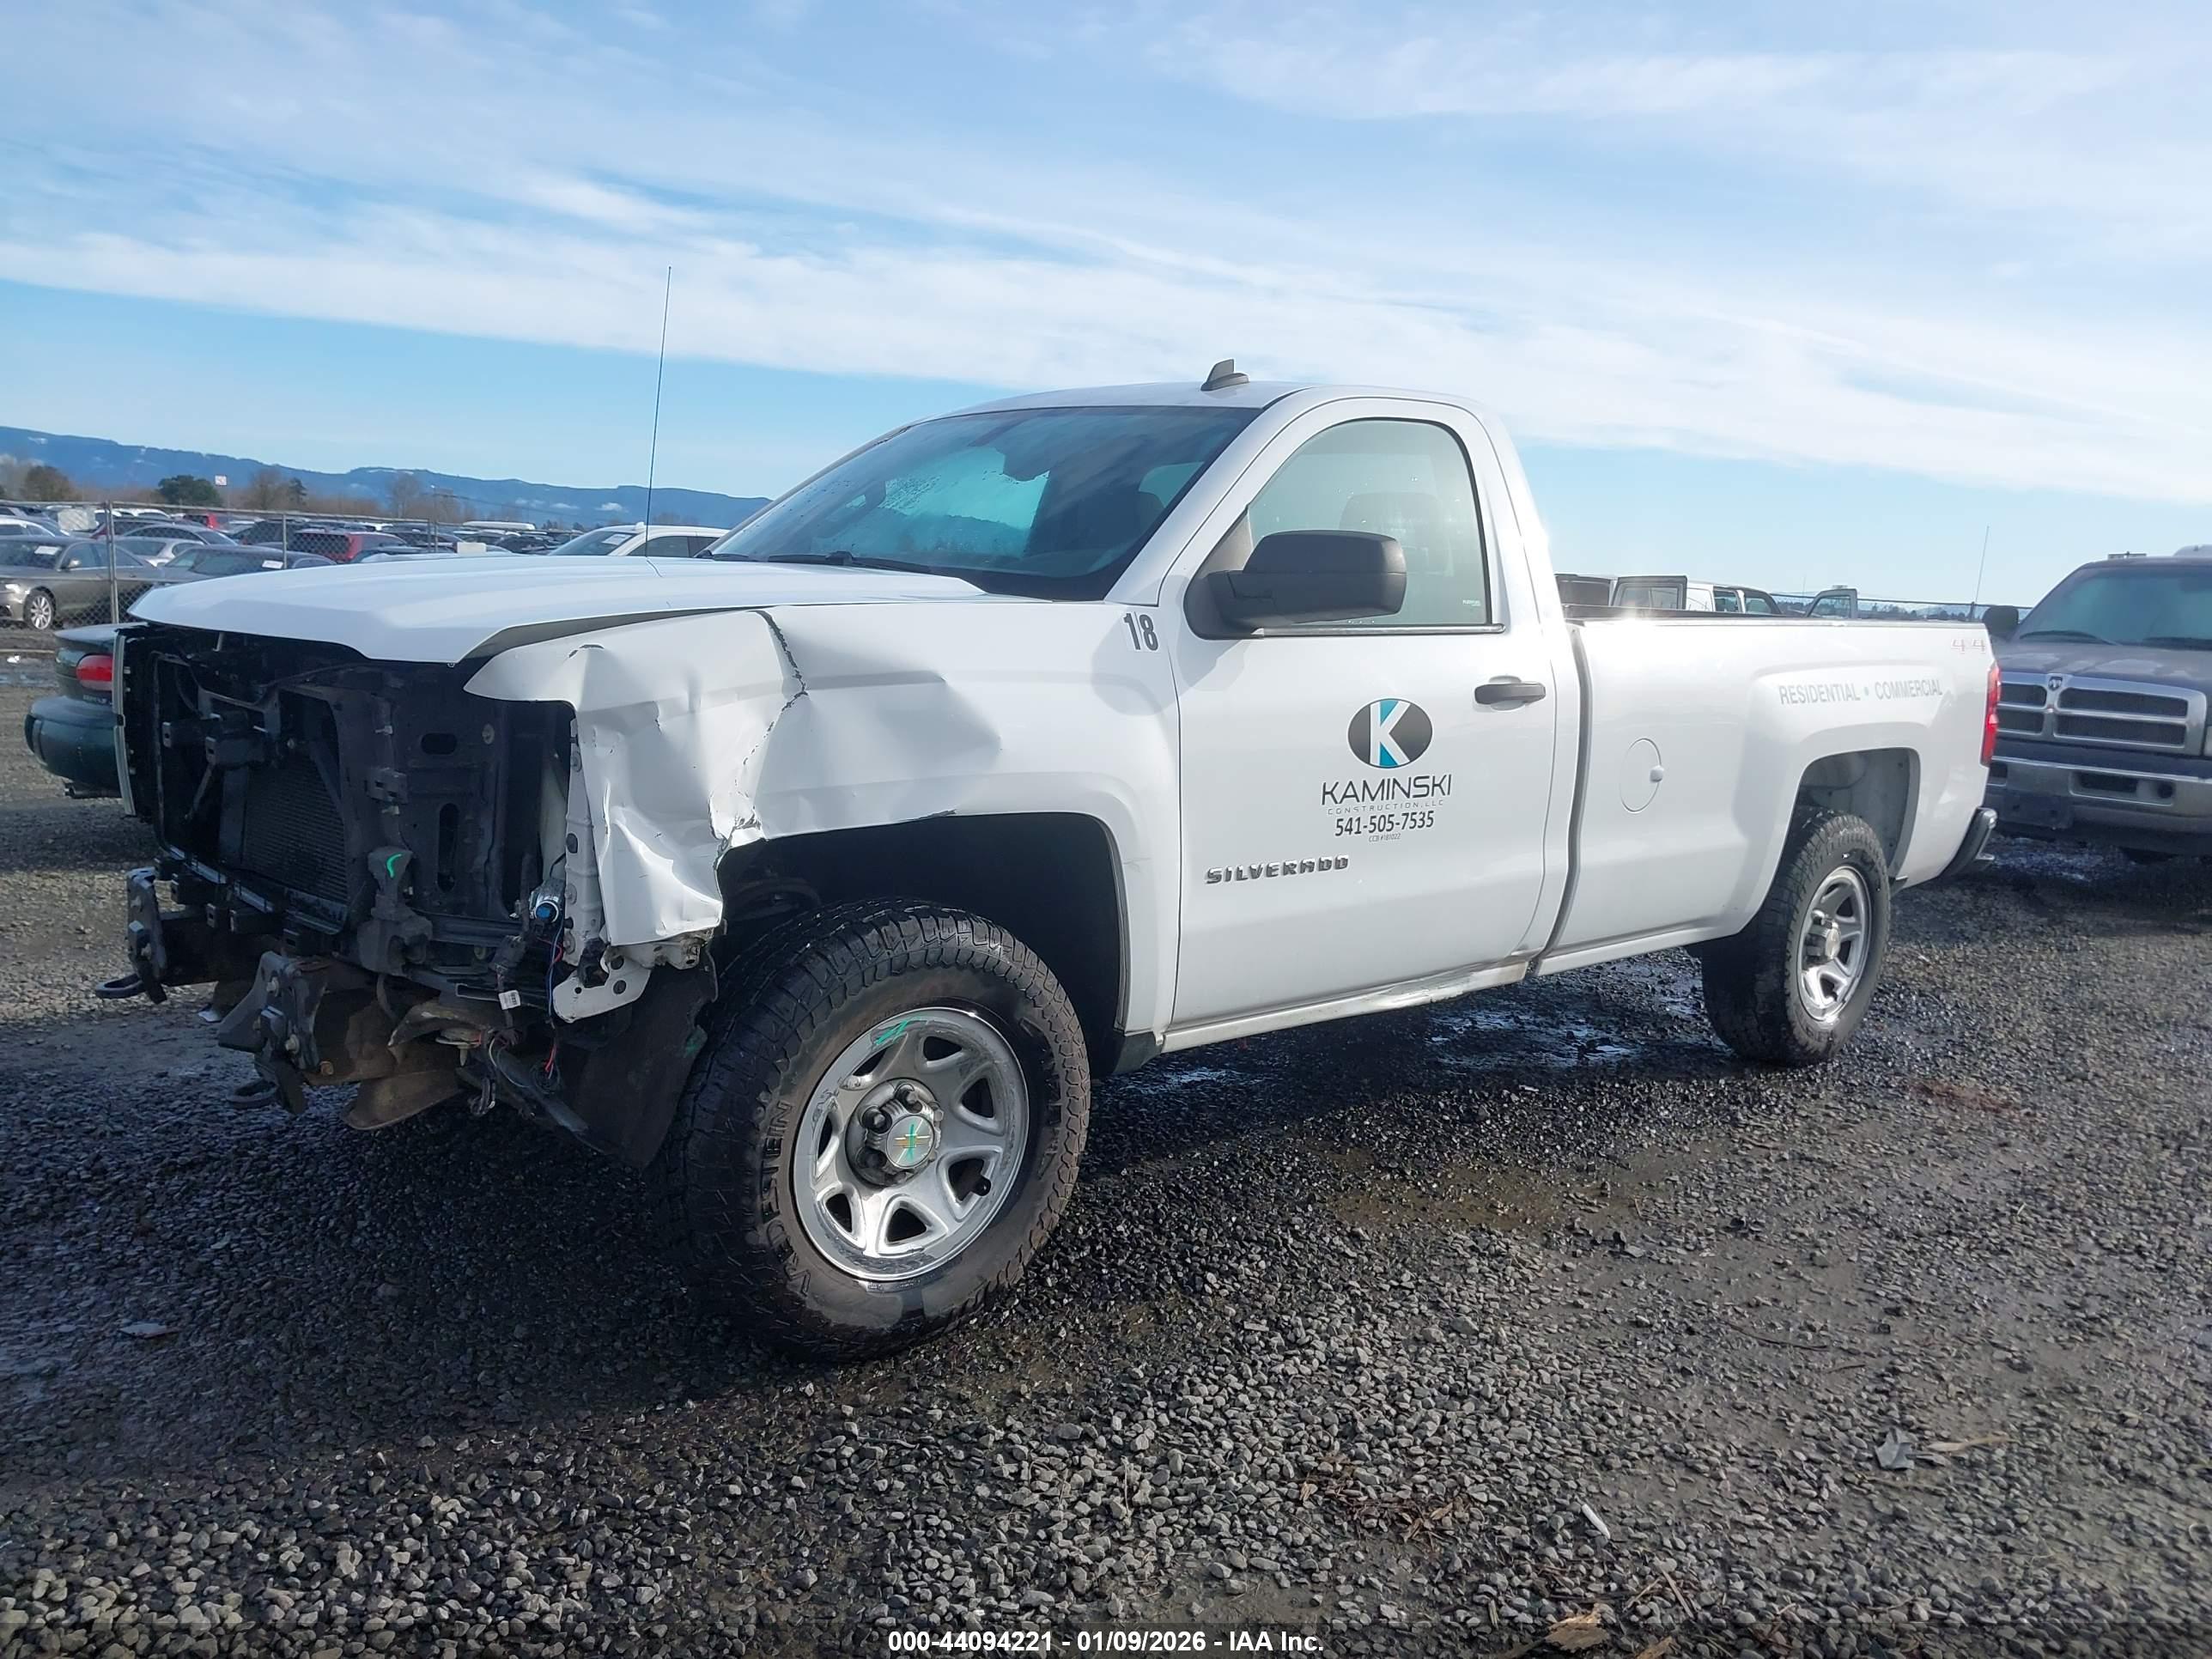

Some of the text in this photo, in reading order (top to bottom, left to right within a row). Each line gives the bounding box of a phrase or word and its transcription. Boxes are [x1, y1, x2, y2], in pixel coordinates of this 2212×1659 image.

[1123, 612, 1159, 651] 18
[1779, 679, 1942, 704] RESIDENTIAL COMMERCIAL
[1370, 700, 1411, 767] K
[1322, 774, 1452, 805] KAMINSKI
[1335, 811, 1434, 836] 541-505-7535
[1206, 854, 1349, 884] SILVERADO
